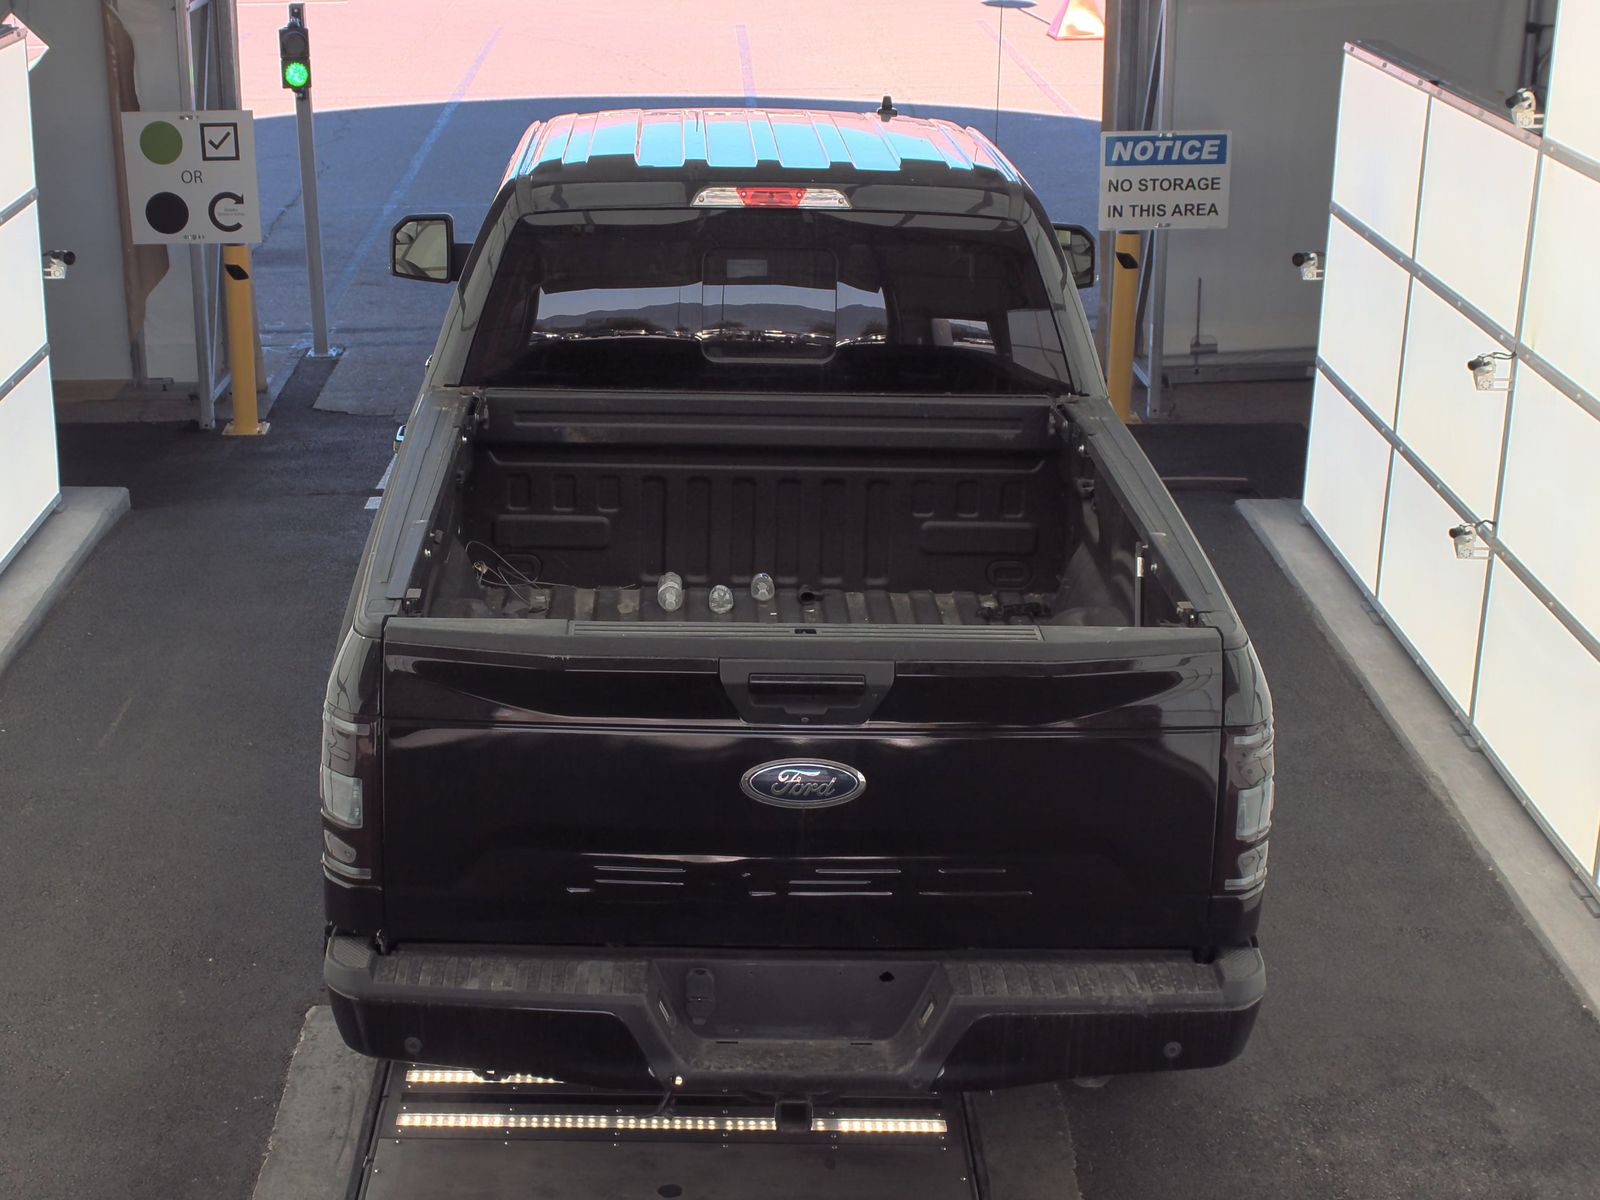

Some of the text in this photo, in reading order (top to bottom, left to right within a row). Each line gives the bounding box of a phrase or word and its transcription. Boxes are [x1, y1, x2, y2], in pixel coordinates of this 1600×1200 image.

[1111, 139, 1221, 161] NOTICE
[181, 170, 203, 184] OR
[1108, 177, 1221, 192] NO STORAGE
[1107, 203, 1219, 218] IN THIS AREA
[770, 769, 837, 797] Ford
